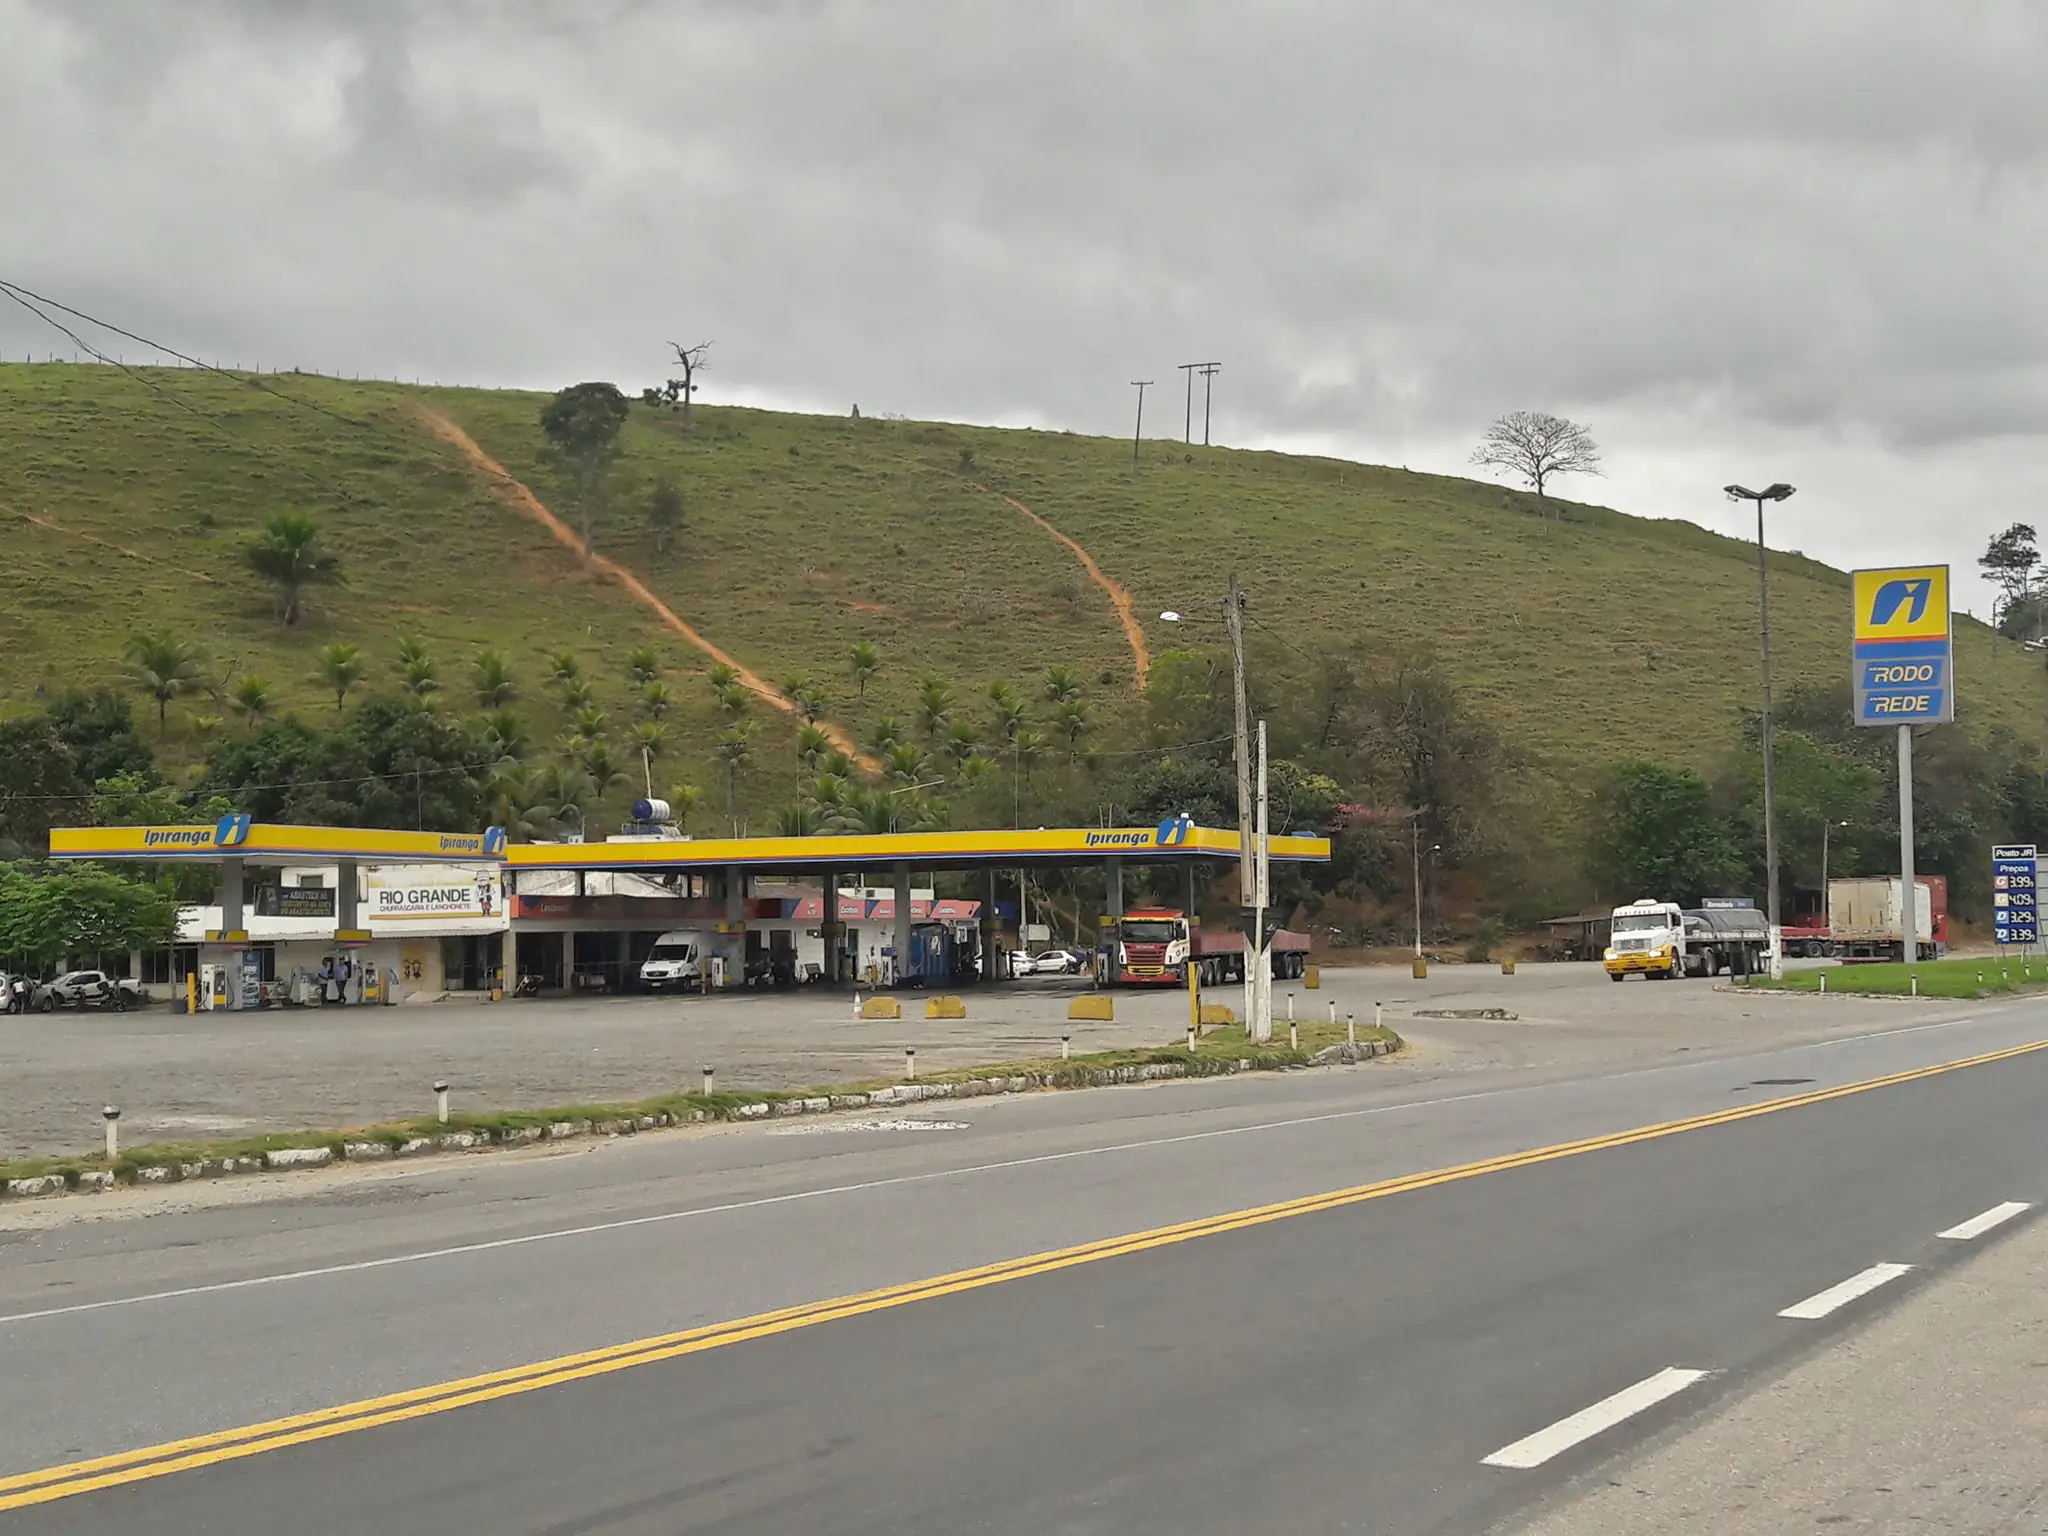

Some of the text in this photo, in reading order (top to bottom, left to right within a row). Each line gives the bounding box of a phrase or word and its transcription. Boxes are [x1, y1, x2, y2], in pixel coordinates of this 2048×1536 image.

[1869, 665, 1933, 683] RODO
[1870, 695, 1930, 713] REDE
[144, 828, 211, 846] Ipiranga
[440, 835, 479, 852] Ipiranga
[1085, 832, 1150, 846] Ipiranga
[1996, 849, 2033, 857] Posto JR
[2000, 865, 2029, 874] Preços
[380, 888, 471, 904] RIO GRANDE
[379, 904, 425, 912] CHURRASCARIA
